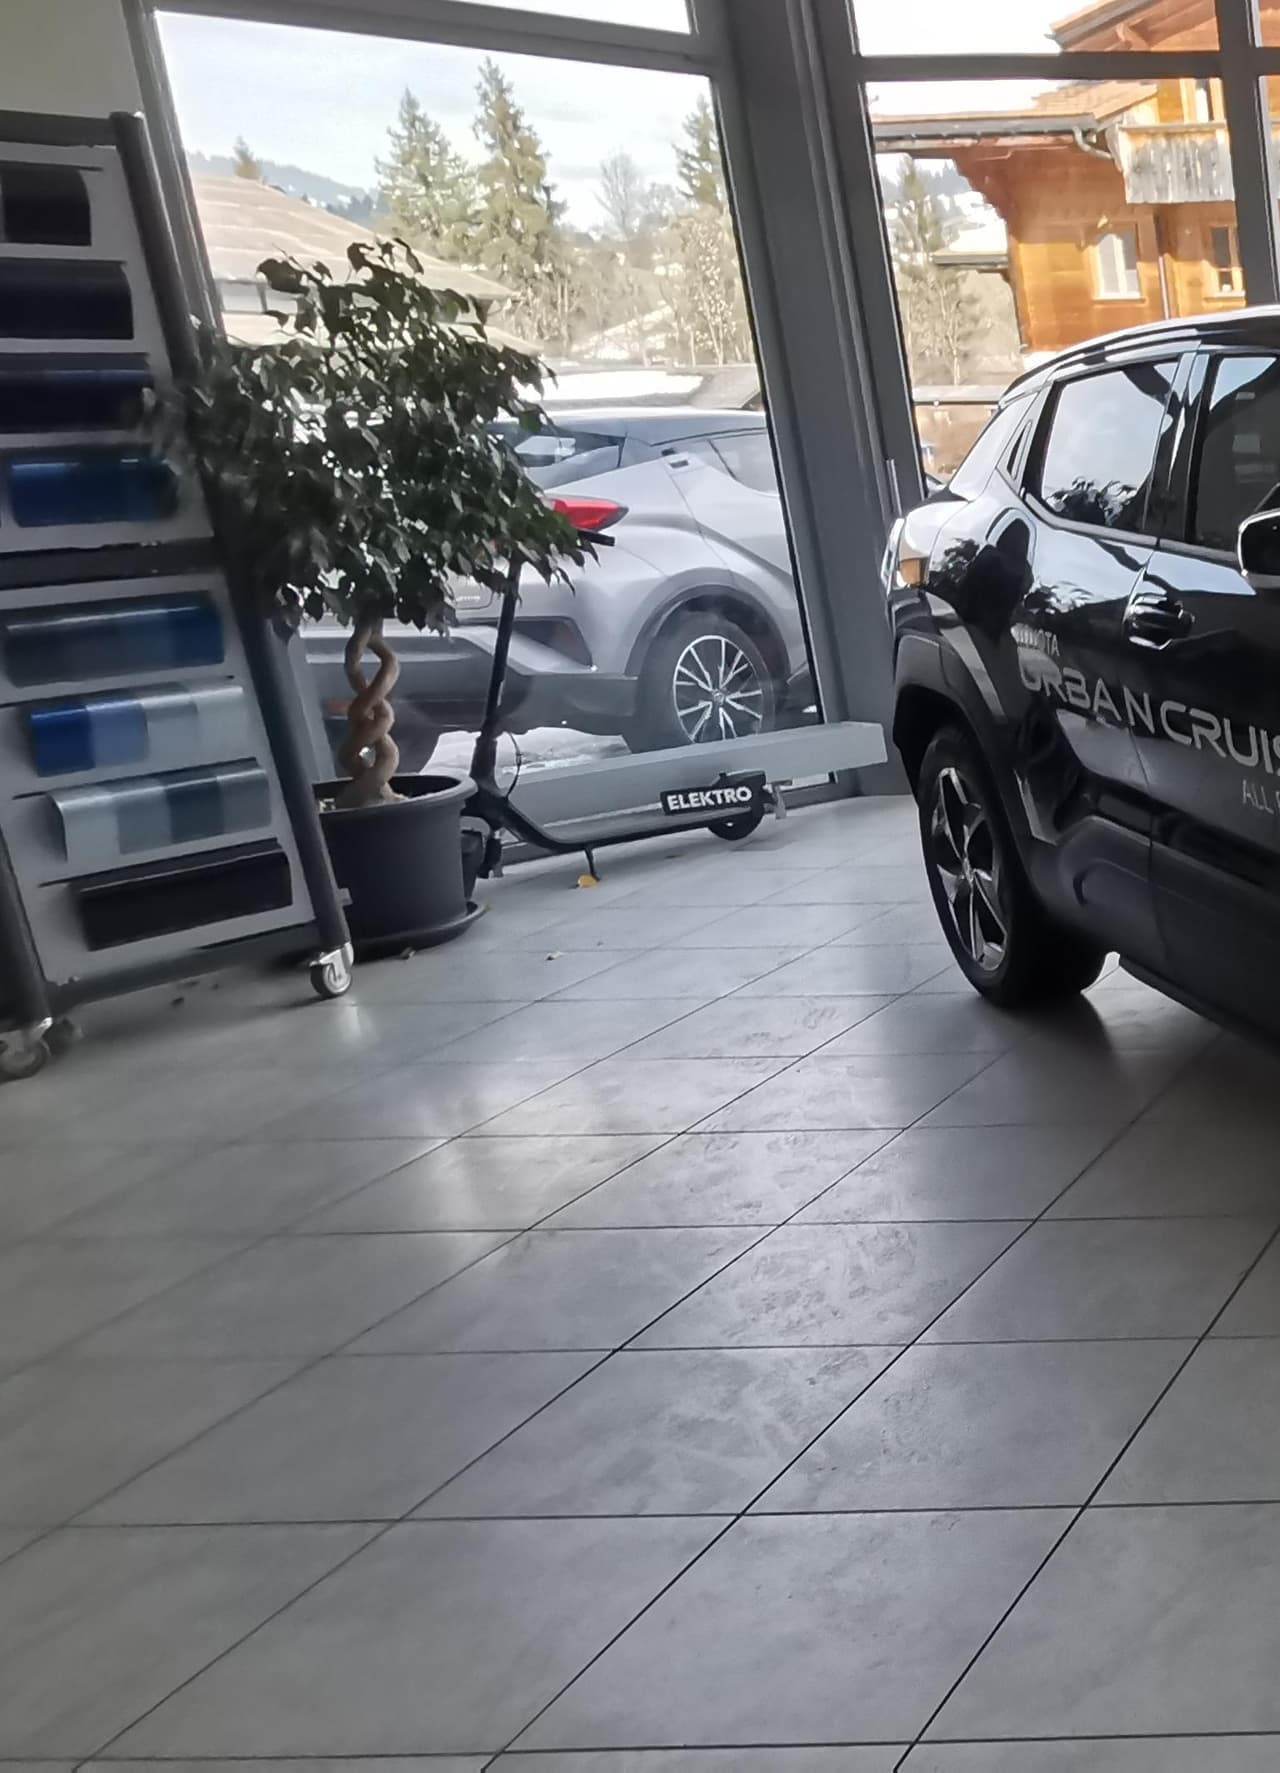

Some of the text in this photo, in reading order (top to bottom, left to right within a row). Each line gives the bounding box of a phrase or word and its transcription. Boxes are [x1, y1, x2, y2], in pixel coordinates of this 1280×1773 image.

[1017, 647, 1156, 735] URBAN
[666, 786, 752, 811] ELEKTRO
[1242, 779, 1275, 815] ALL
